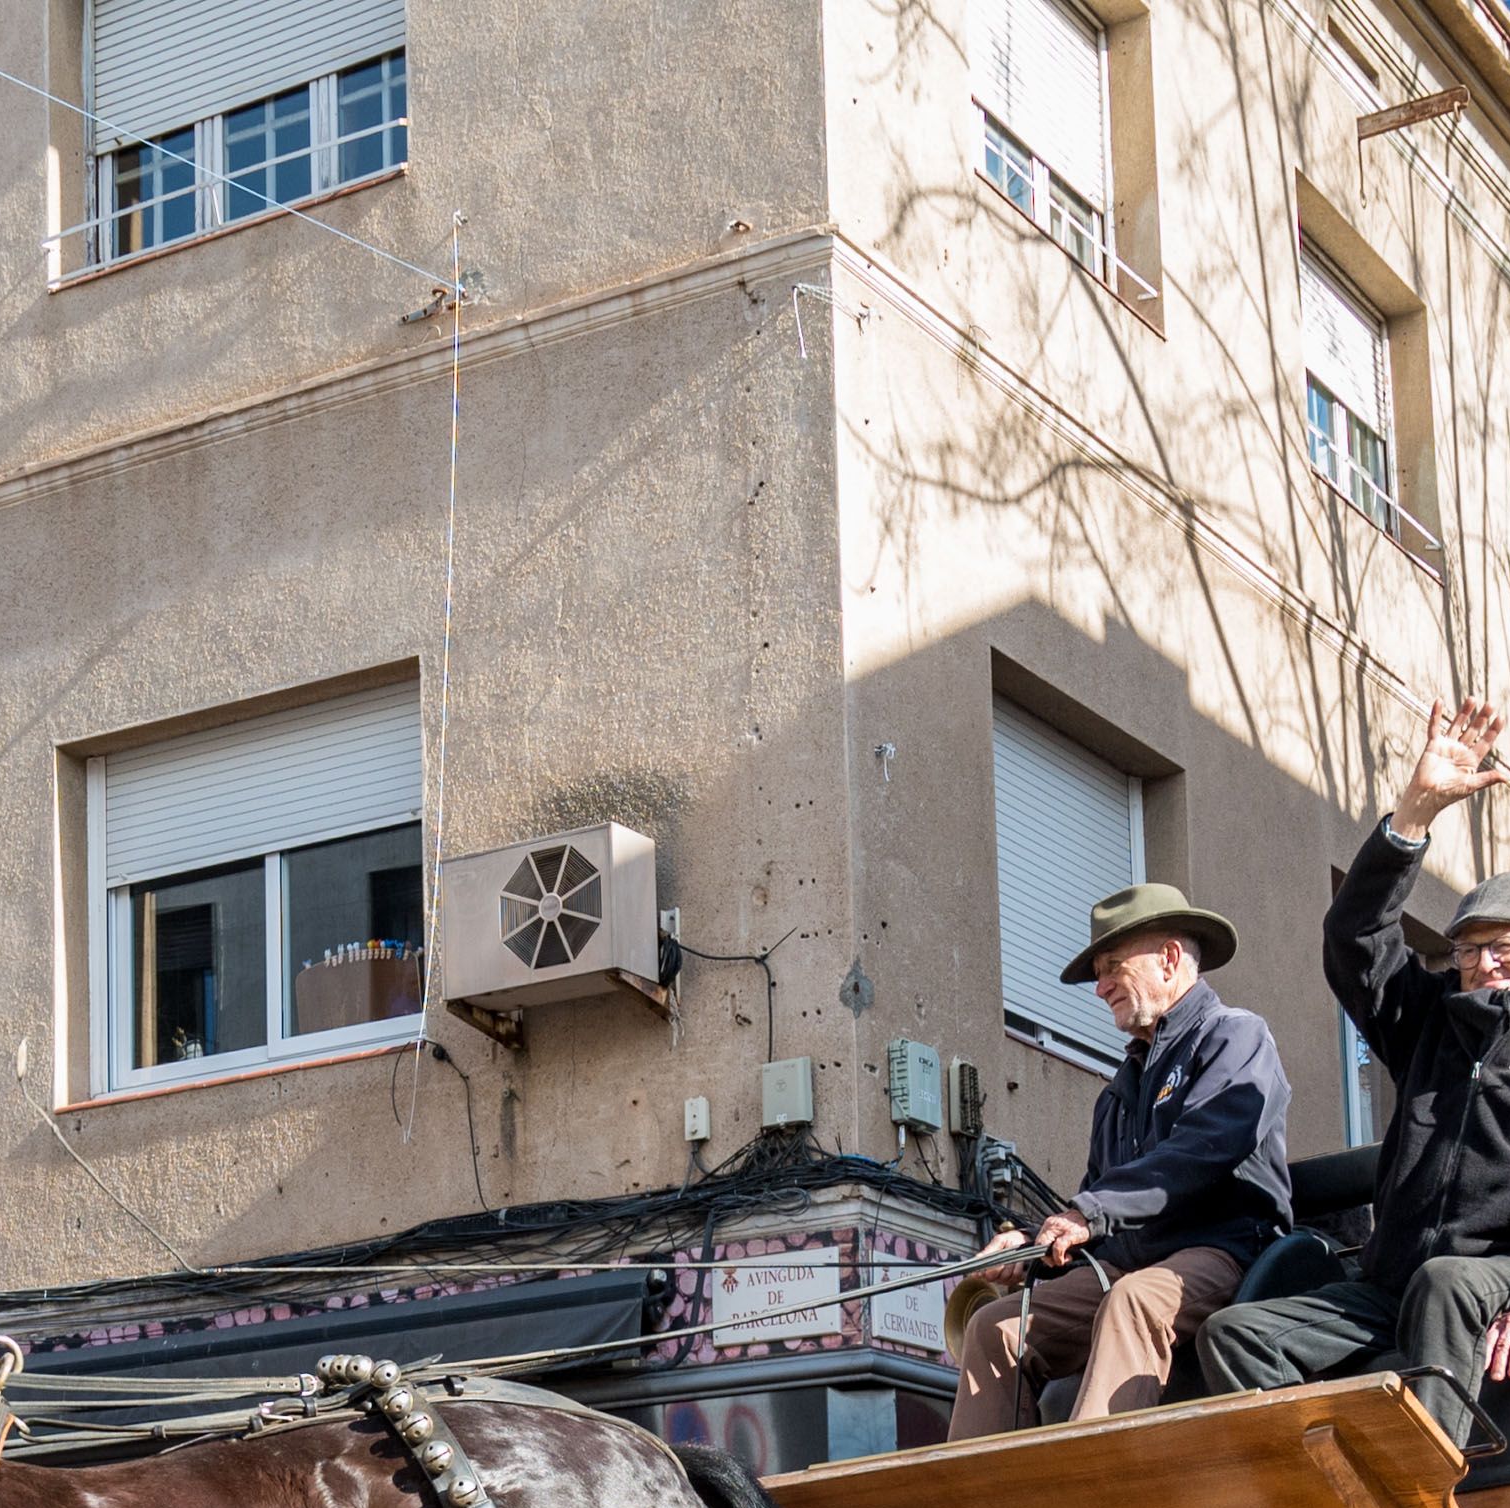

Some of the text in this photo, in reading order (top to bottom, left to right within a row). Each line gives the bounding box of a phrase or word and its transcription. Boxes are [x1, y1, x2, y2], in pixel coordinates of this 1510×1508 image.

[746, 1265, 816, 1288] AVINGUDA
[767, 1289, 785, 1306] DE
[905, 1294, 920, 1312] DE
[883, 1312, 939, 1342] CERVANTES
